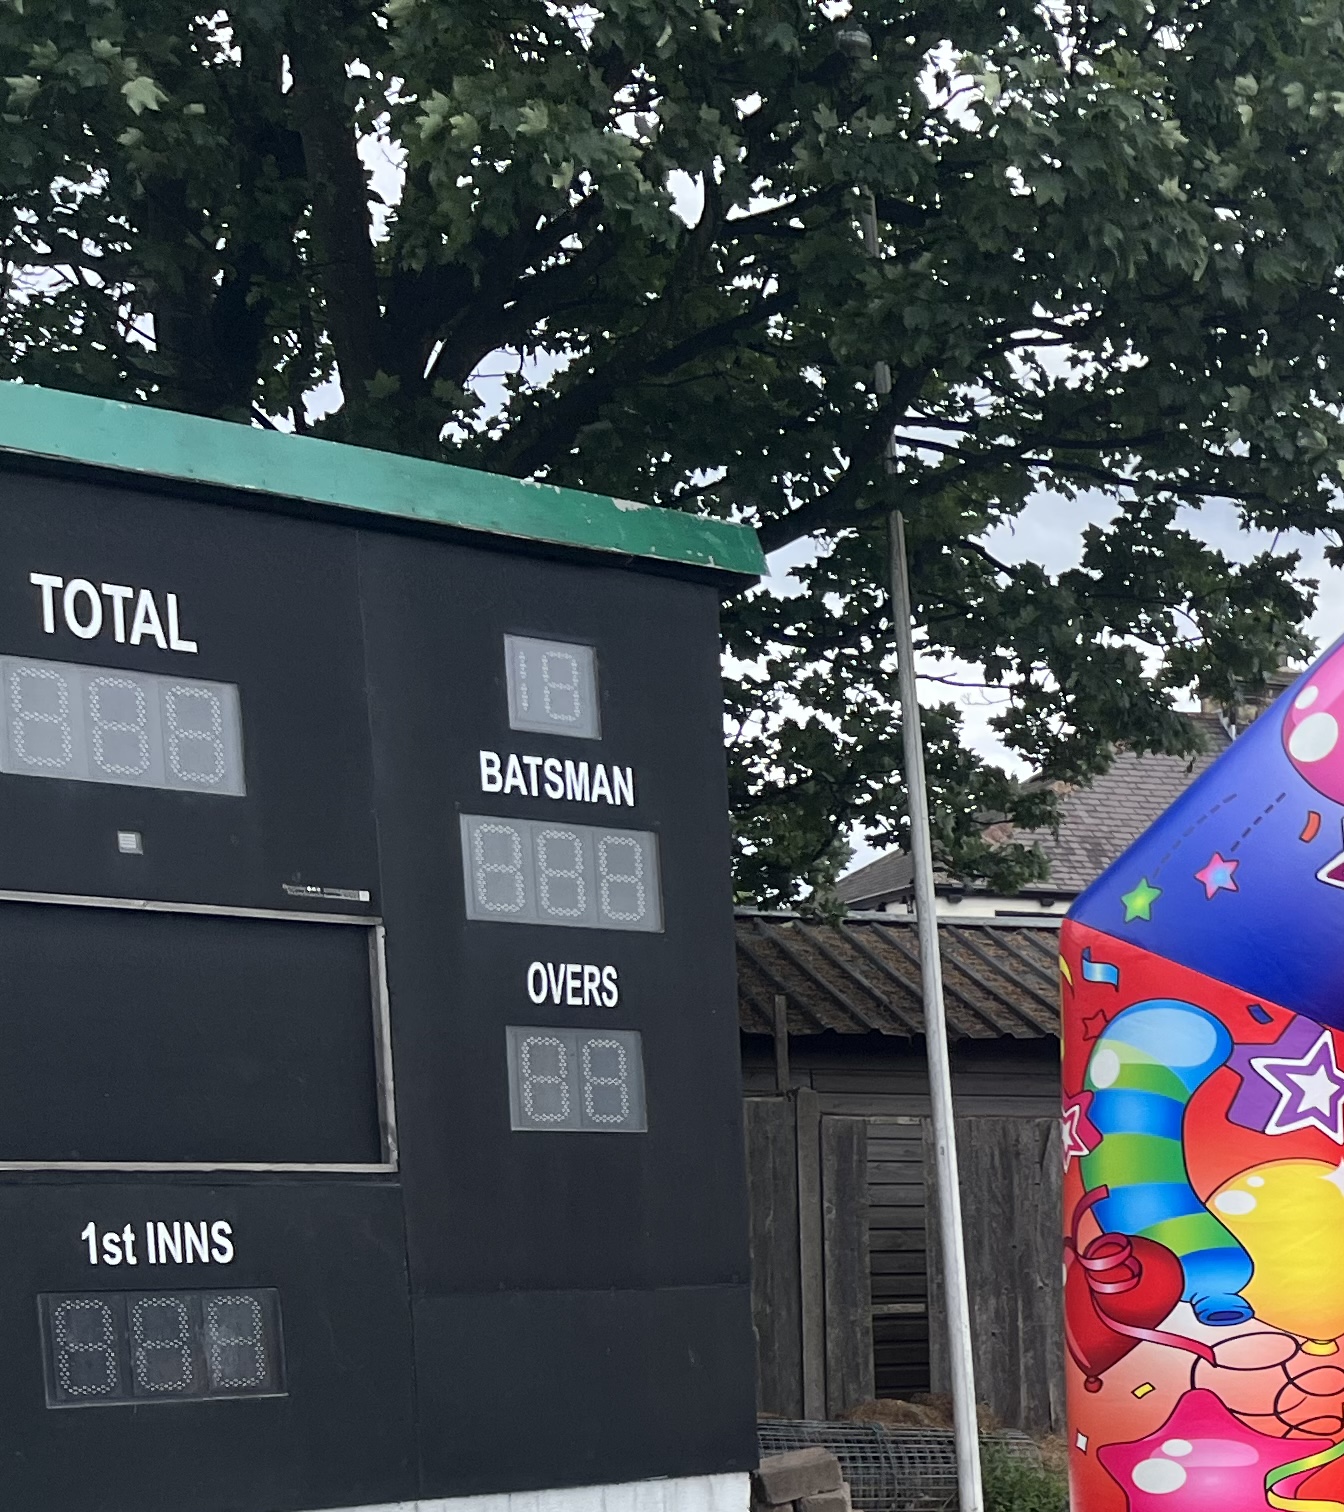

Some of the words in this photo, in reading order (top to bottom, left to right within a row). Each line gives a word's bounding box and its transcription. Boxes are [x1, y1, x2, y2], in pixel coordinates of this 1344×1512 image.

[30, 572, 198, 654] TOTAL
[480, 750, 635, 807] BATSMAN
[527, 961, 618, 1008] OVERS
[81, 1221, 137, 1266] 1st
[146, 1220, 234, 1264] INNS
